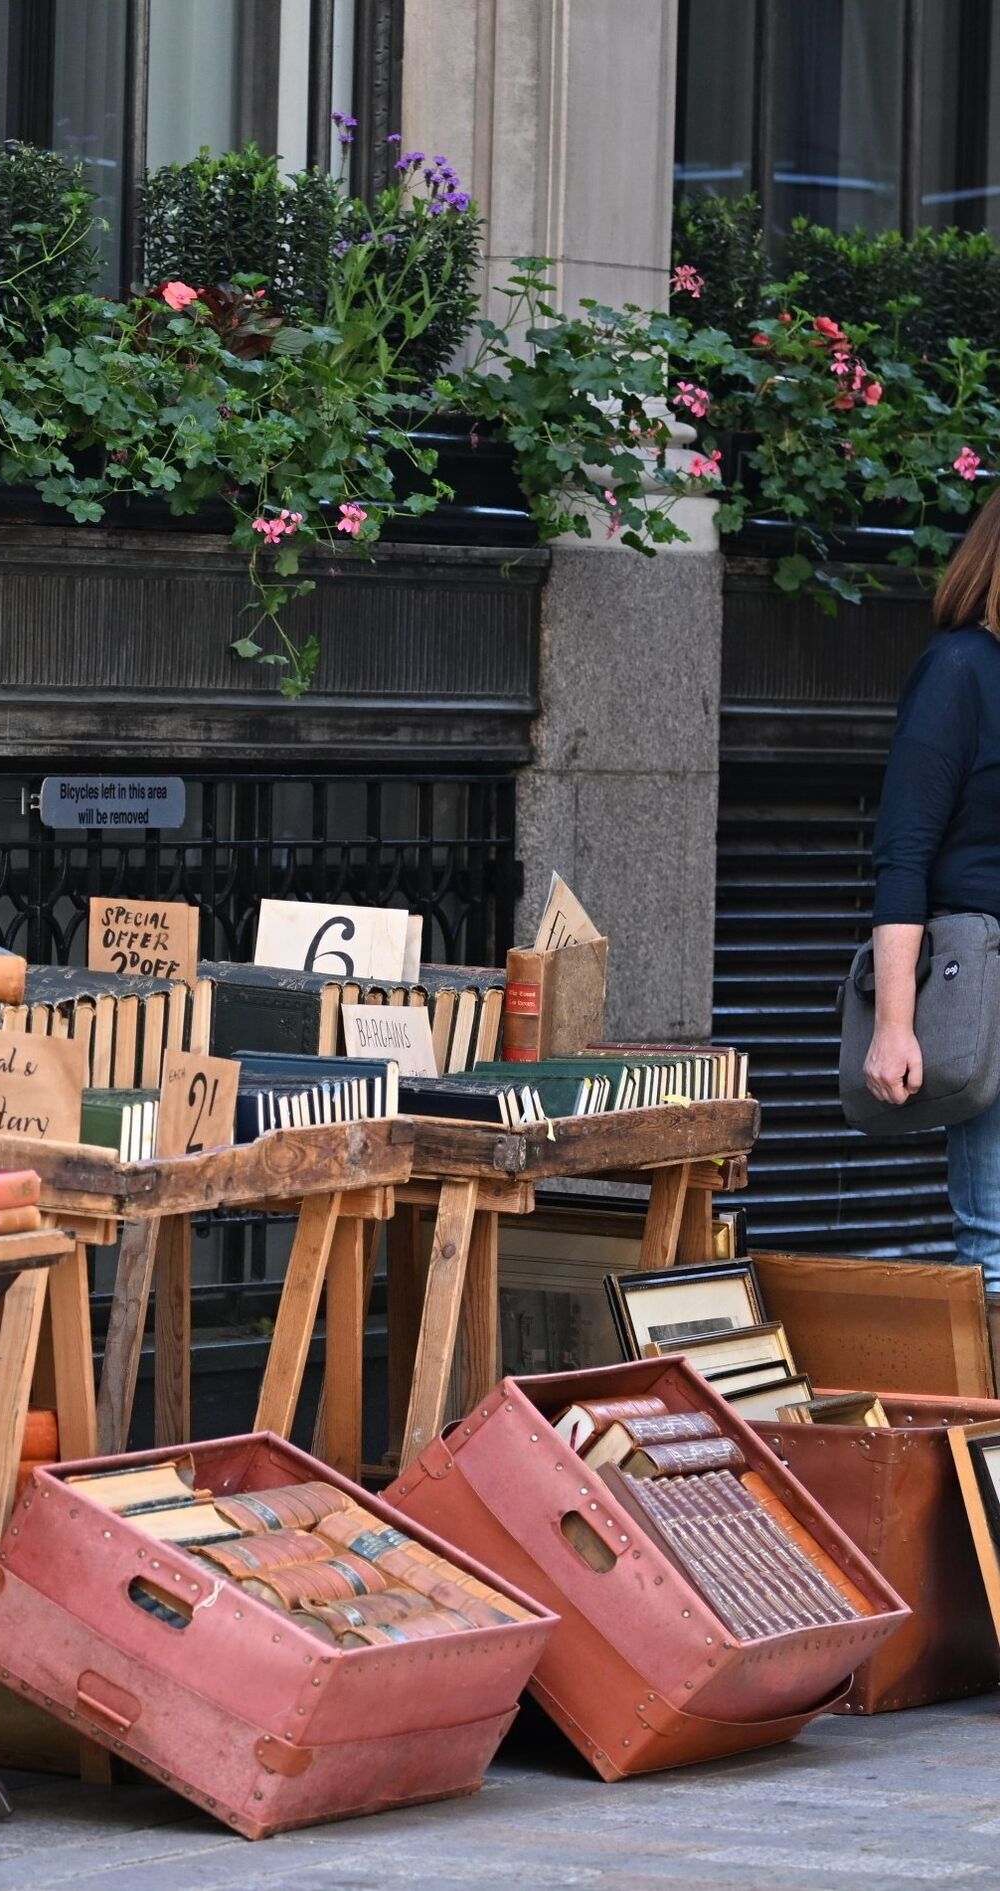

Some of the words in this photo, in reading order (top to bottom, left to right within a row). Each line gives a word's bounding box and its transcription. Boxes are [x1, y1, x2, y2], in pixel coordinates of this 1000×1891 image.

[60, 783, 99, 804] Bicycles
[101, 783, 116, 800] left
[118, 784, 127, 800] in
[129, 783, 146, 800] this
[147, 786, 168, 800] area
[78, 808, 94, 825] will
[96, 809, 108, 825] be
[109, 808, 149, 825] removed
[101, 906, 170, 930] SPECIAL
[102, 928, 169, 951] OFFER
[356, 1017, 412, 1049] BARGAINS
